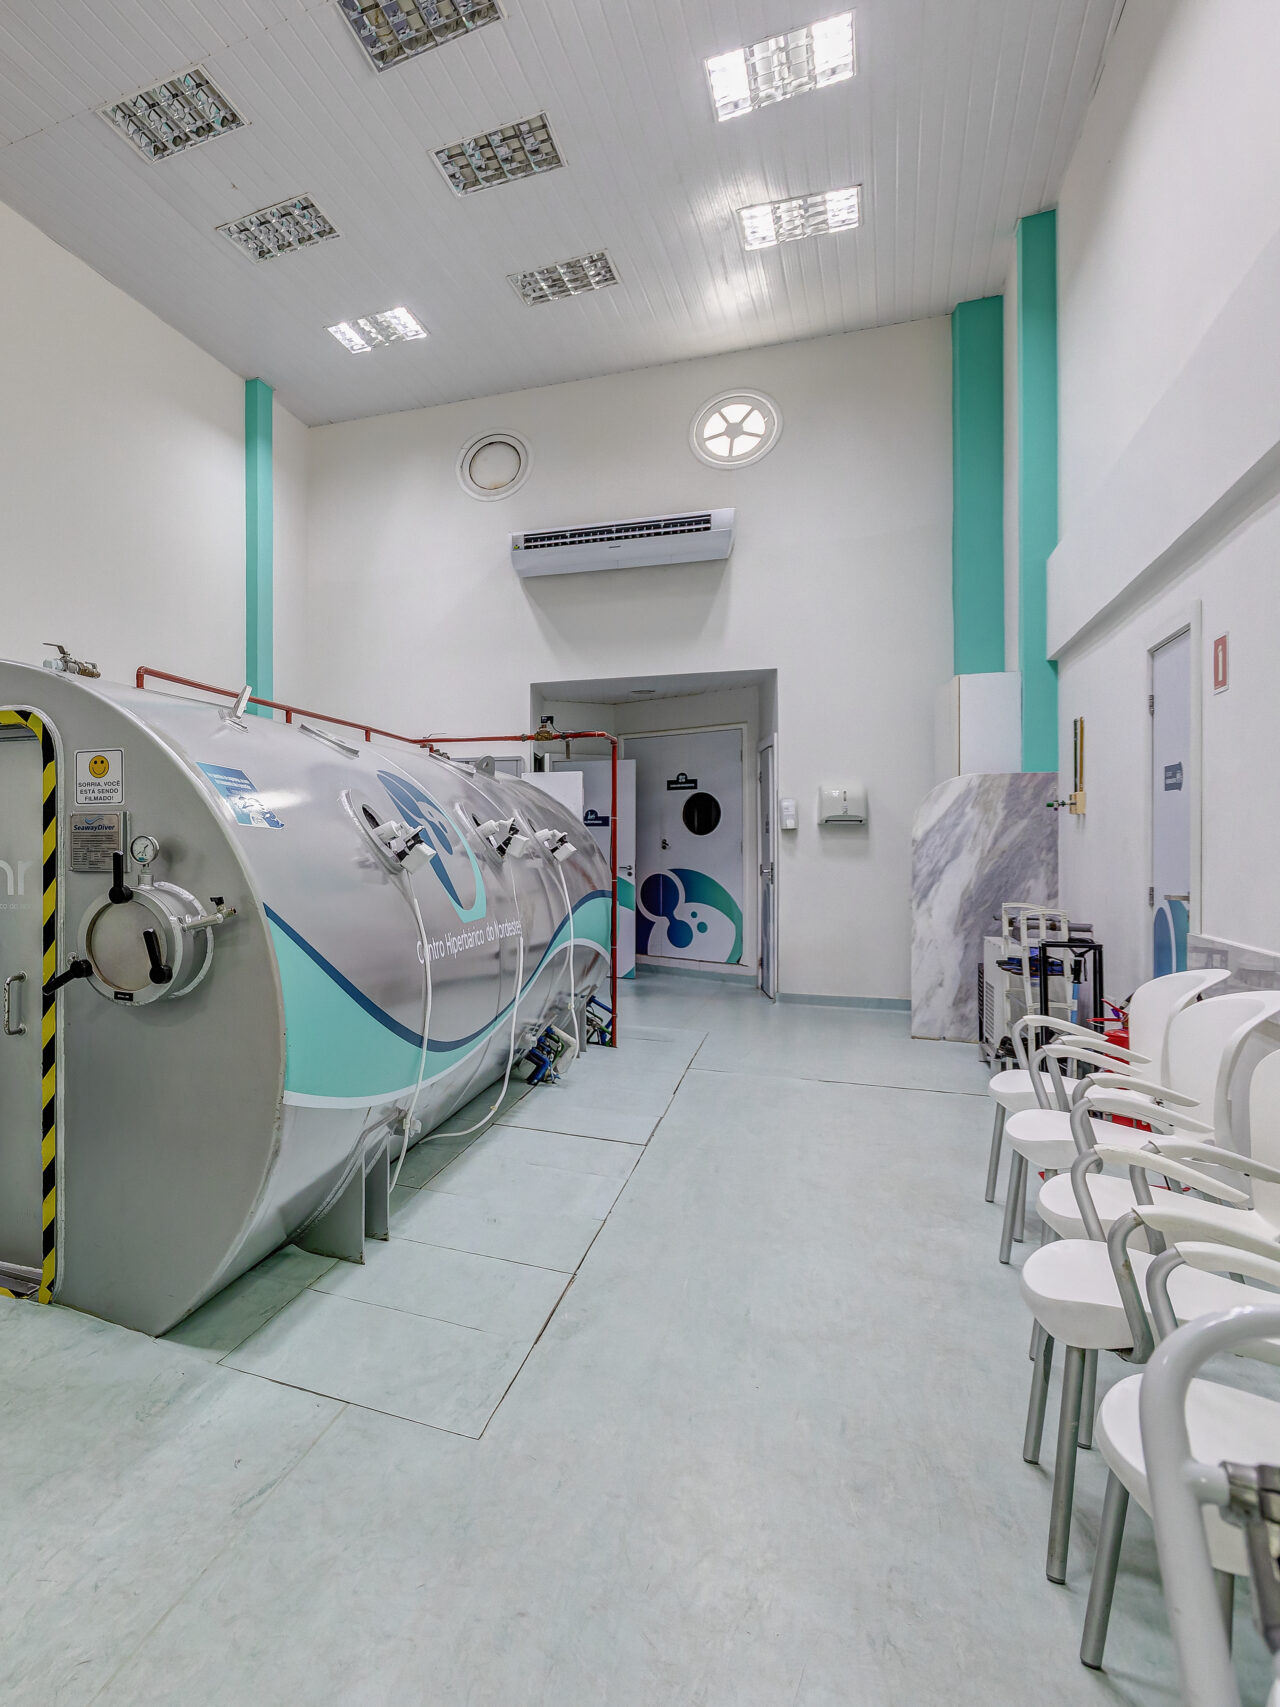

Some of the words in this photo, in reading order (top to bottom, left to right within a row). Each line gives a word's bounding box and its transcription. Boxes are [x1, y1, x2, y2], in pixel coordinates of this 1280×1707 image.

[416, 937, 445, 964] Cntro
[445, 926, 485, 959] Hiperbárico
[485, 922, 495, 941] do
